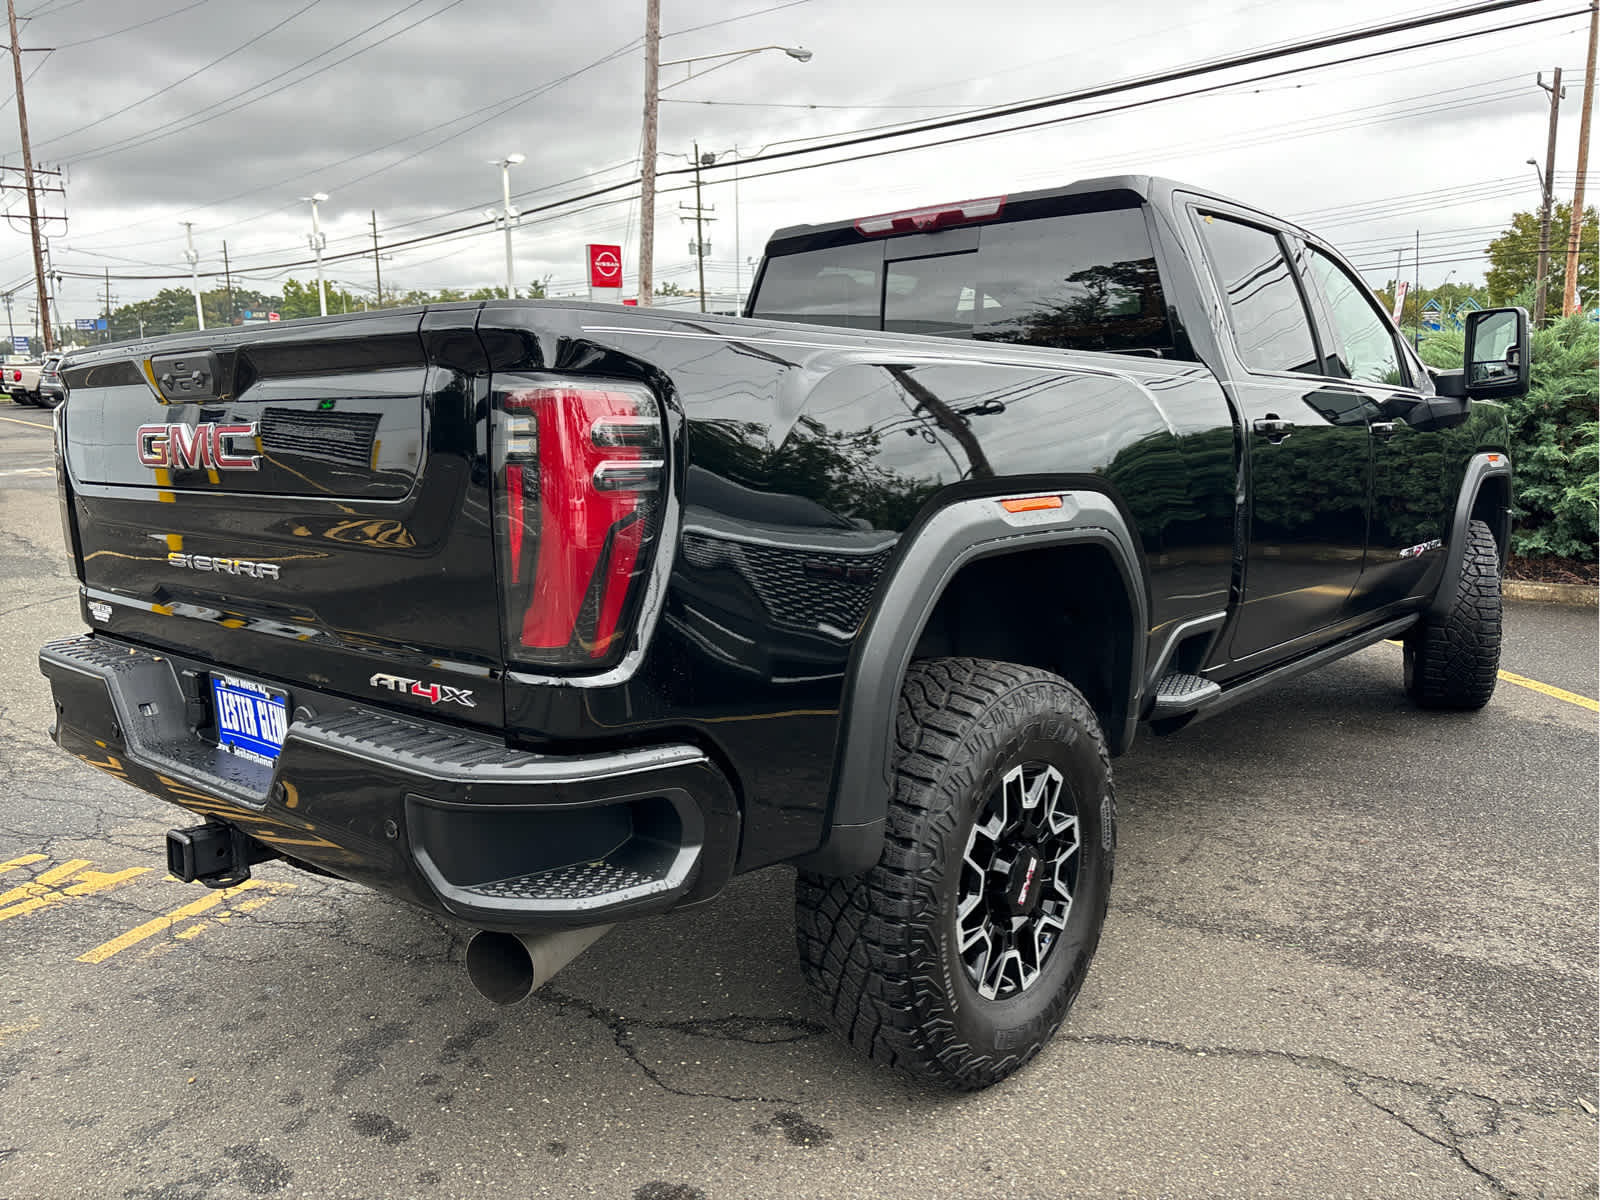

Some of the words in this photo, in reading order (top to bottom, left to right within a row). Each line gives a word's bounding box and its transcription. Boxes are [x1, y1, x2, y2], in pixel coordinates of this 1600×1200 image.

[136, 421, 264, 472] GMC
[168, 552, 281, 580] SIERRA
[369, 672, 477, 708] AT4X
[216, 690, 259, 738] LESTER
